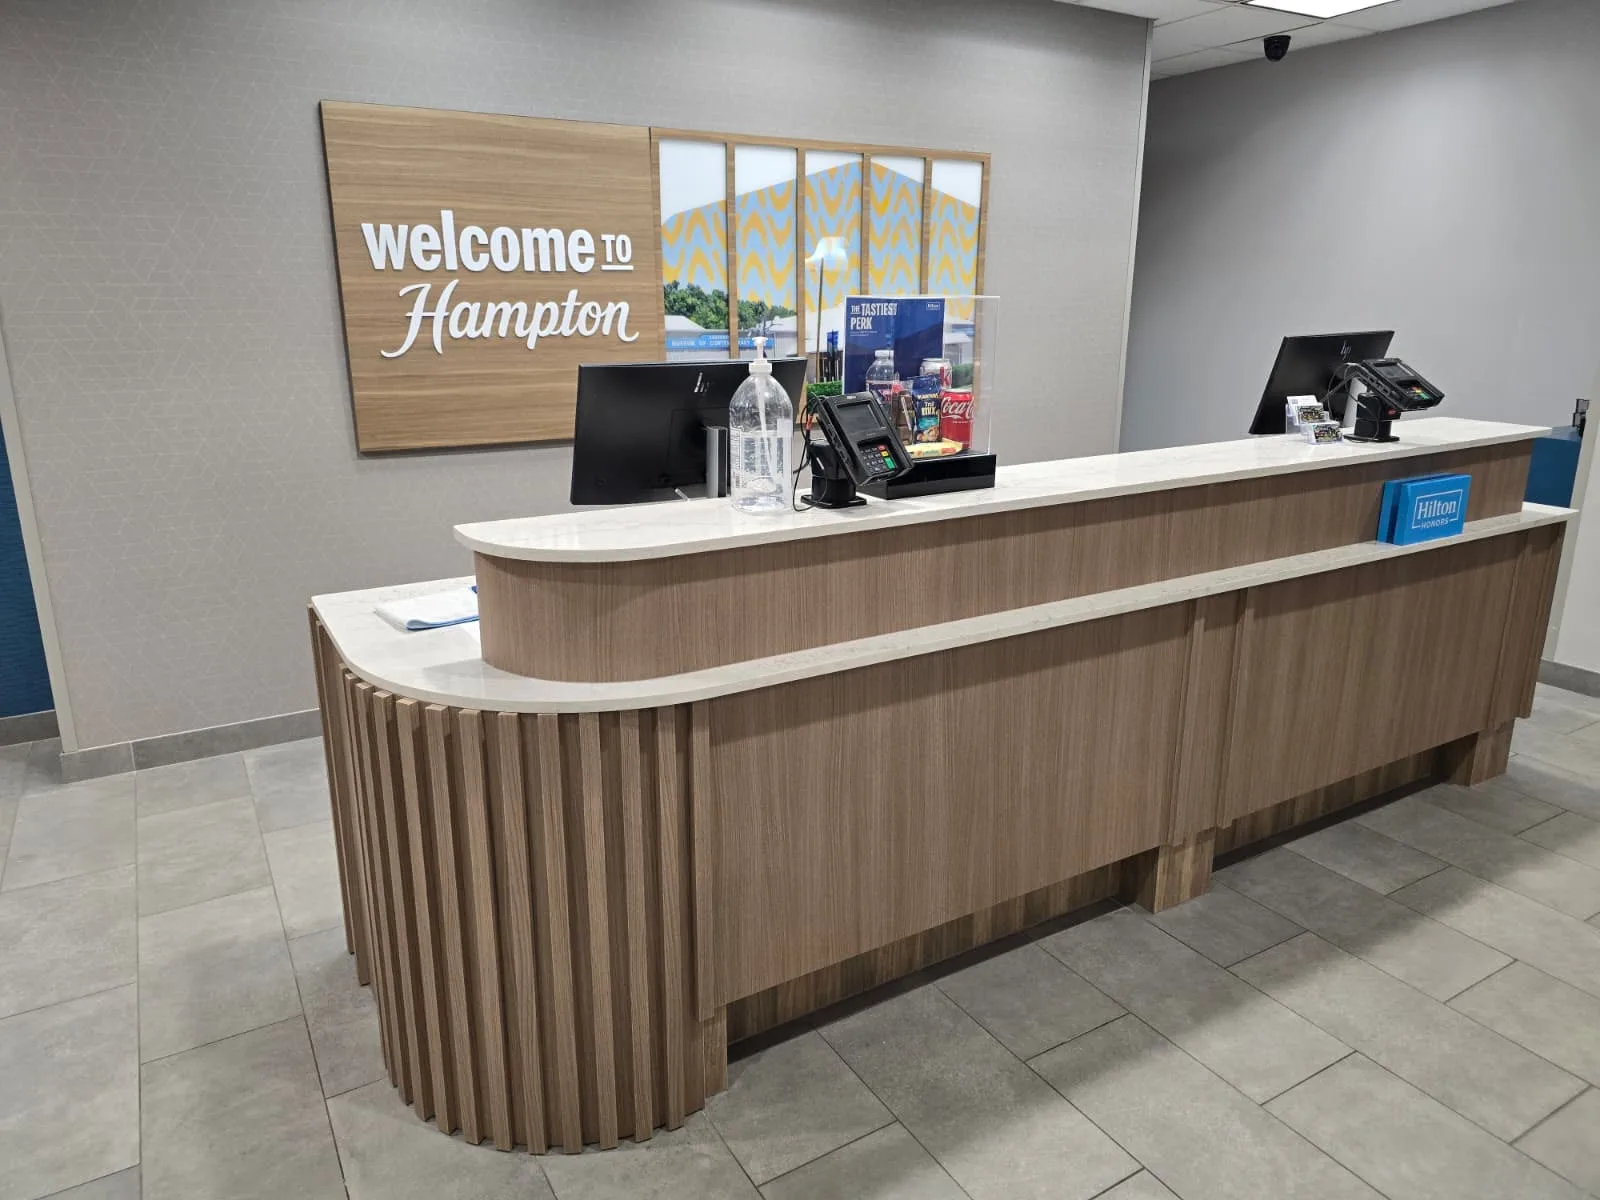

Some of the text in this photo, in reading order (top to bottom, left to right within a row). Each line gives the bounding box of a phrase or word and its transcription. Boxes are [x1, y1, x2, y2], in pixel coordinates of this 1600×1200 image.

[361, 210, 634, 273] welcome TO
[861, 303, 897, 316] TASTIEST
[380, 279, 640, 358] Hampton
[850, 317, 872, 330] PERK
[1416, 500, 1457, 520] Hilton
[1421, 518, 1449, 529] HONORS
